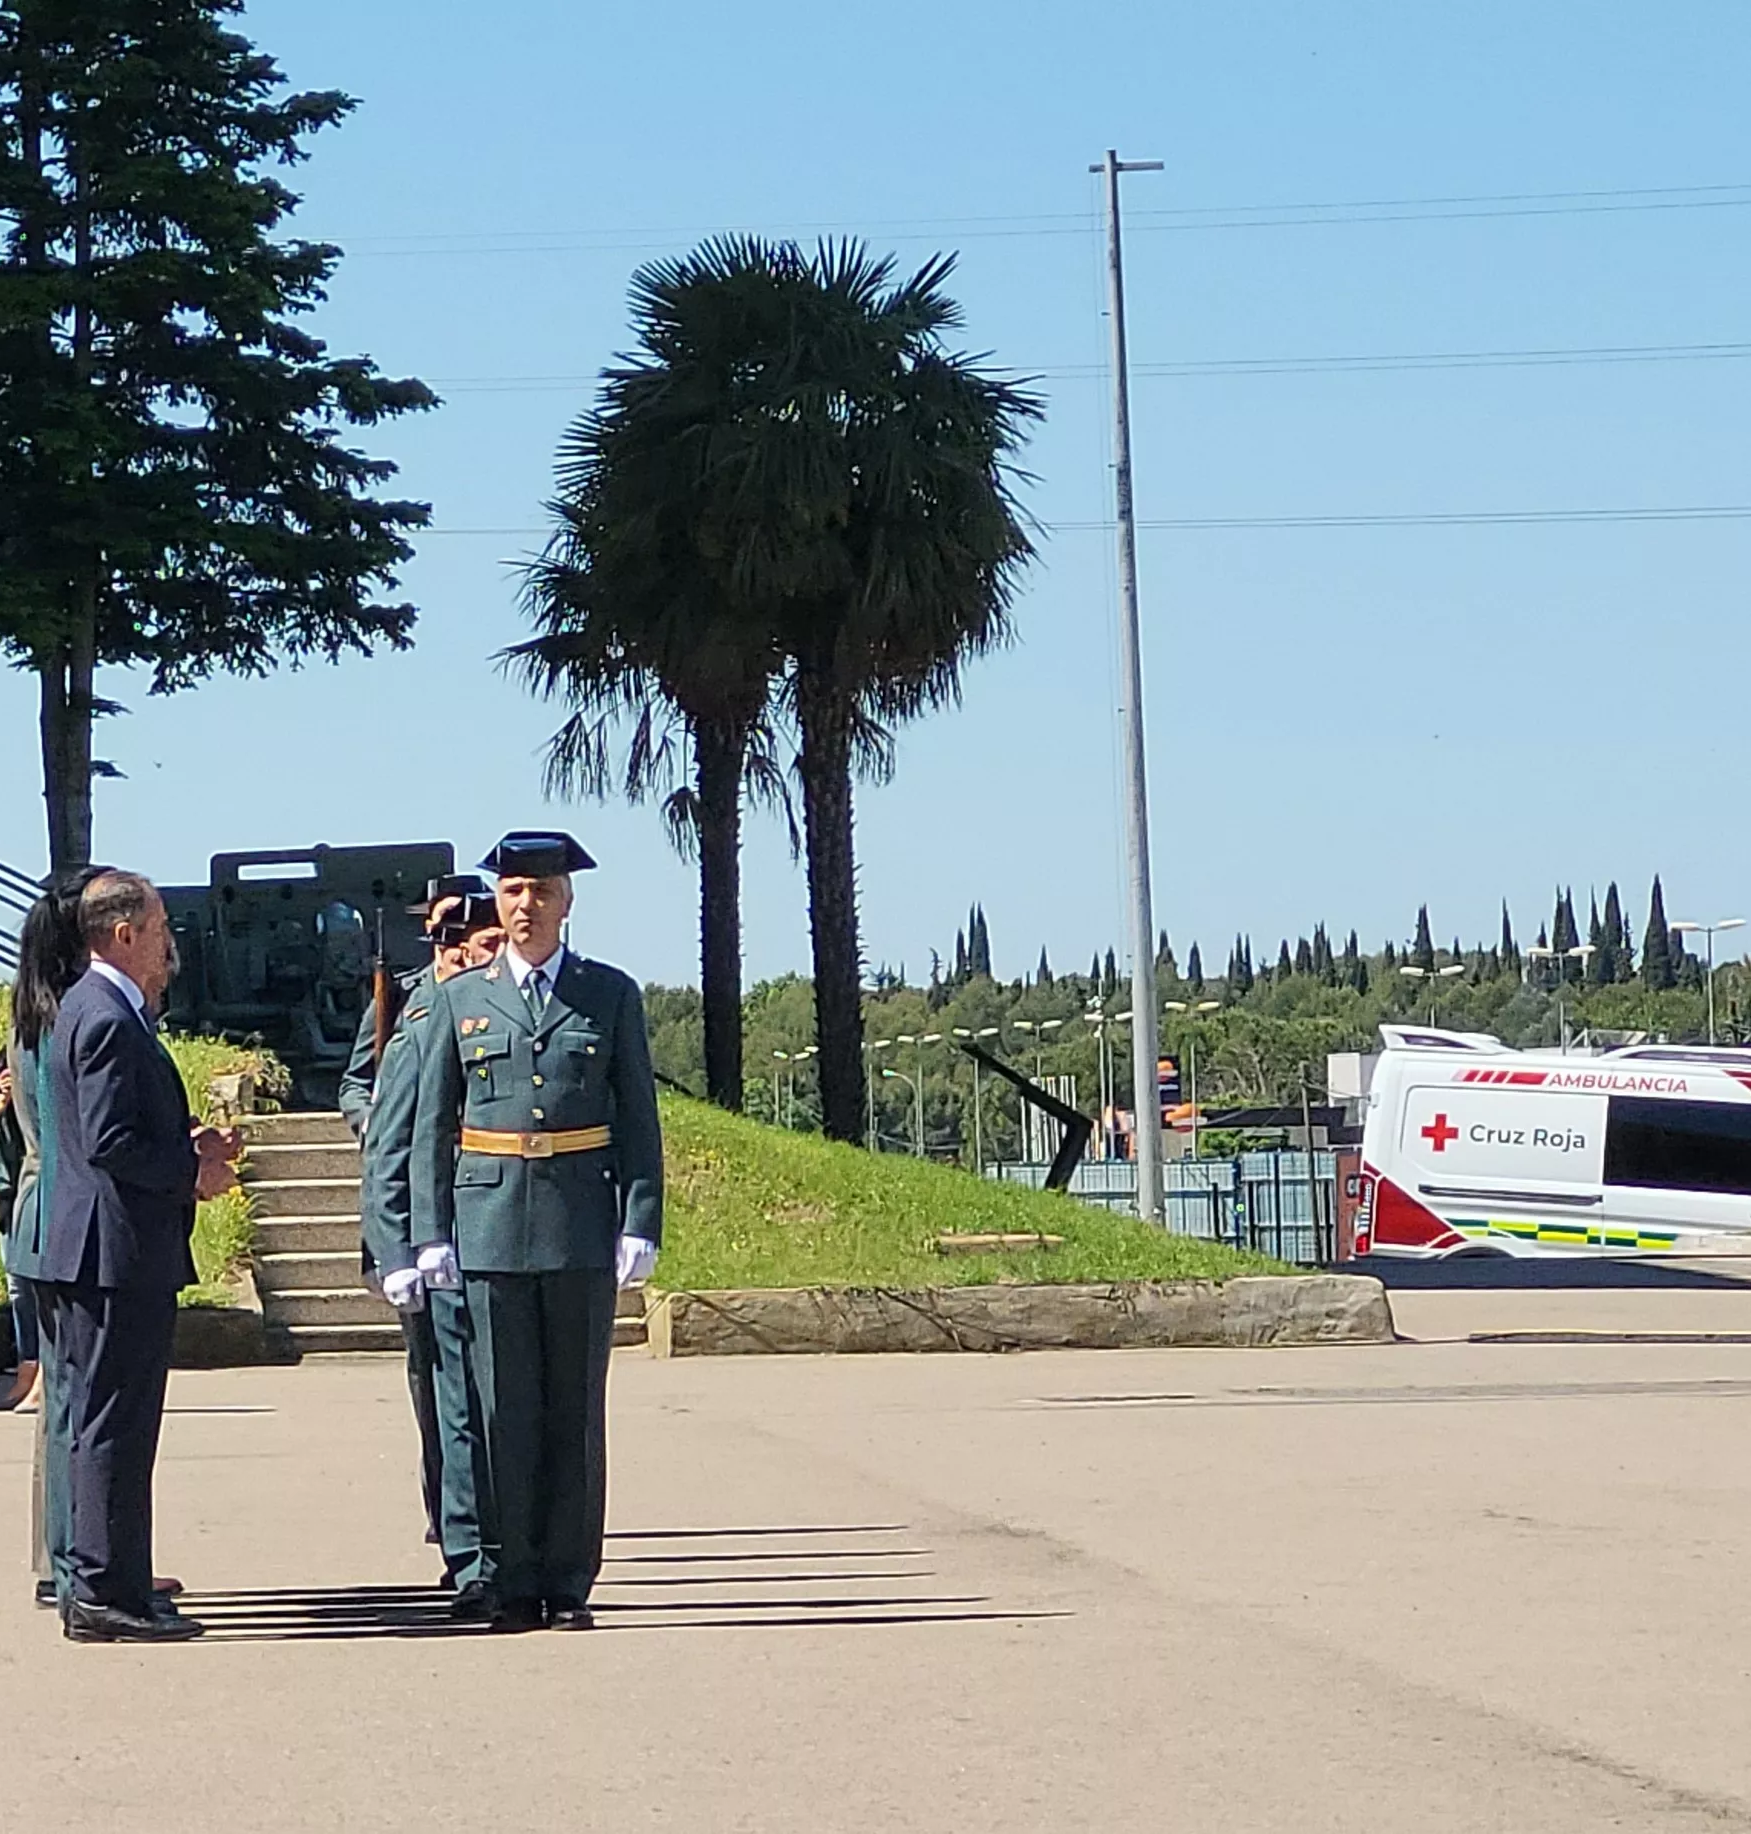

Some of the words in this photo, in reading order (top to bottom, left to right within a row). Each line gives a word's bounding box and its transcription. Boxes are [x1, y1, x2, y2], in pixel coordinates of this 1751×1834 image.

[1548, 1073, 1688, 1093] AMBULANCIA
[1469, 1124, 1525, 1146] Cruz
[1533, 1128, 1586, 1151] Roja
